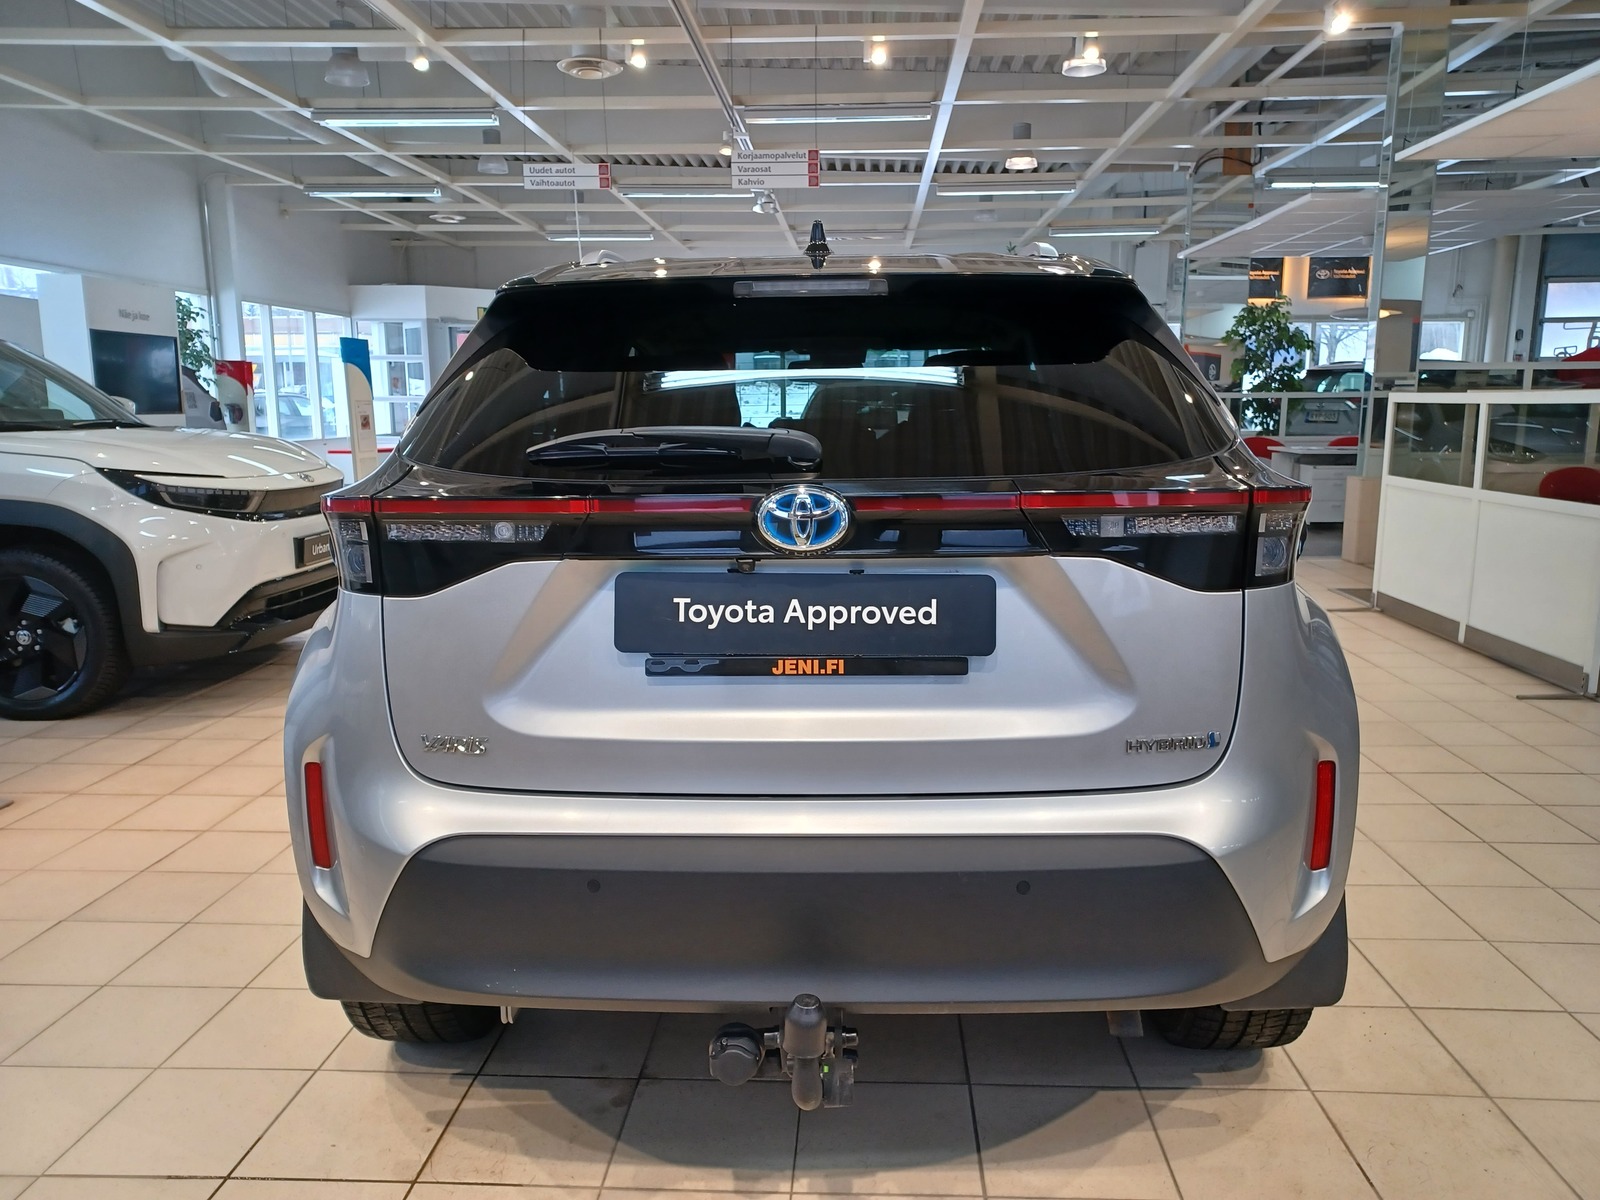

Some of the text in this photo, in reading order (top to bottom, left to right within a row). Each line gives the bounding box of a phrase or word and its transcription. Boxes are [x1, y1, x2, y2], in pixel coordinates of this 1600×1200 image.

[737, 152, 807, 161] Korjaamopalvelut
[530, 179, 576, 187] Vaihtoautot
[673, 597, 937, 630] Toyota Approved
[772, 658, 845, 675] JENI.FI
[1126, 736, 1206, 753] HYBRID
